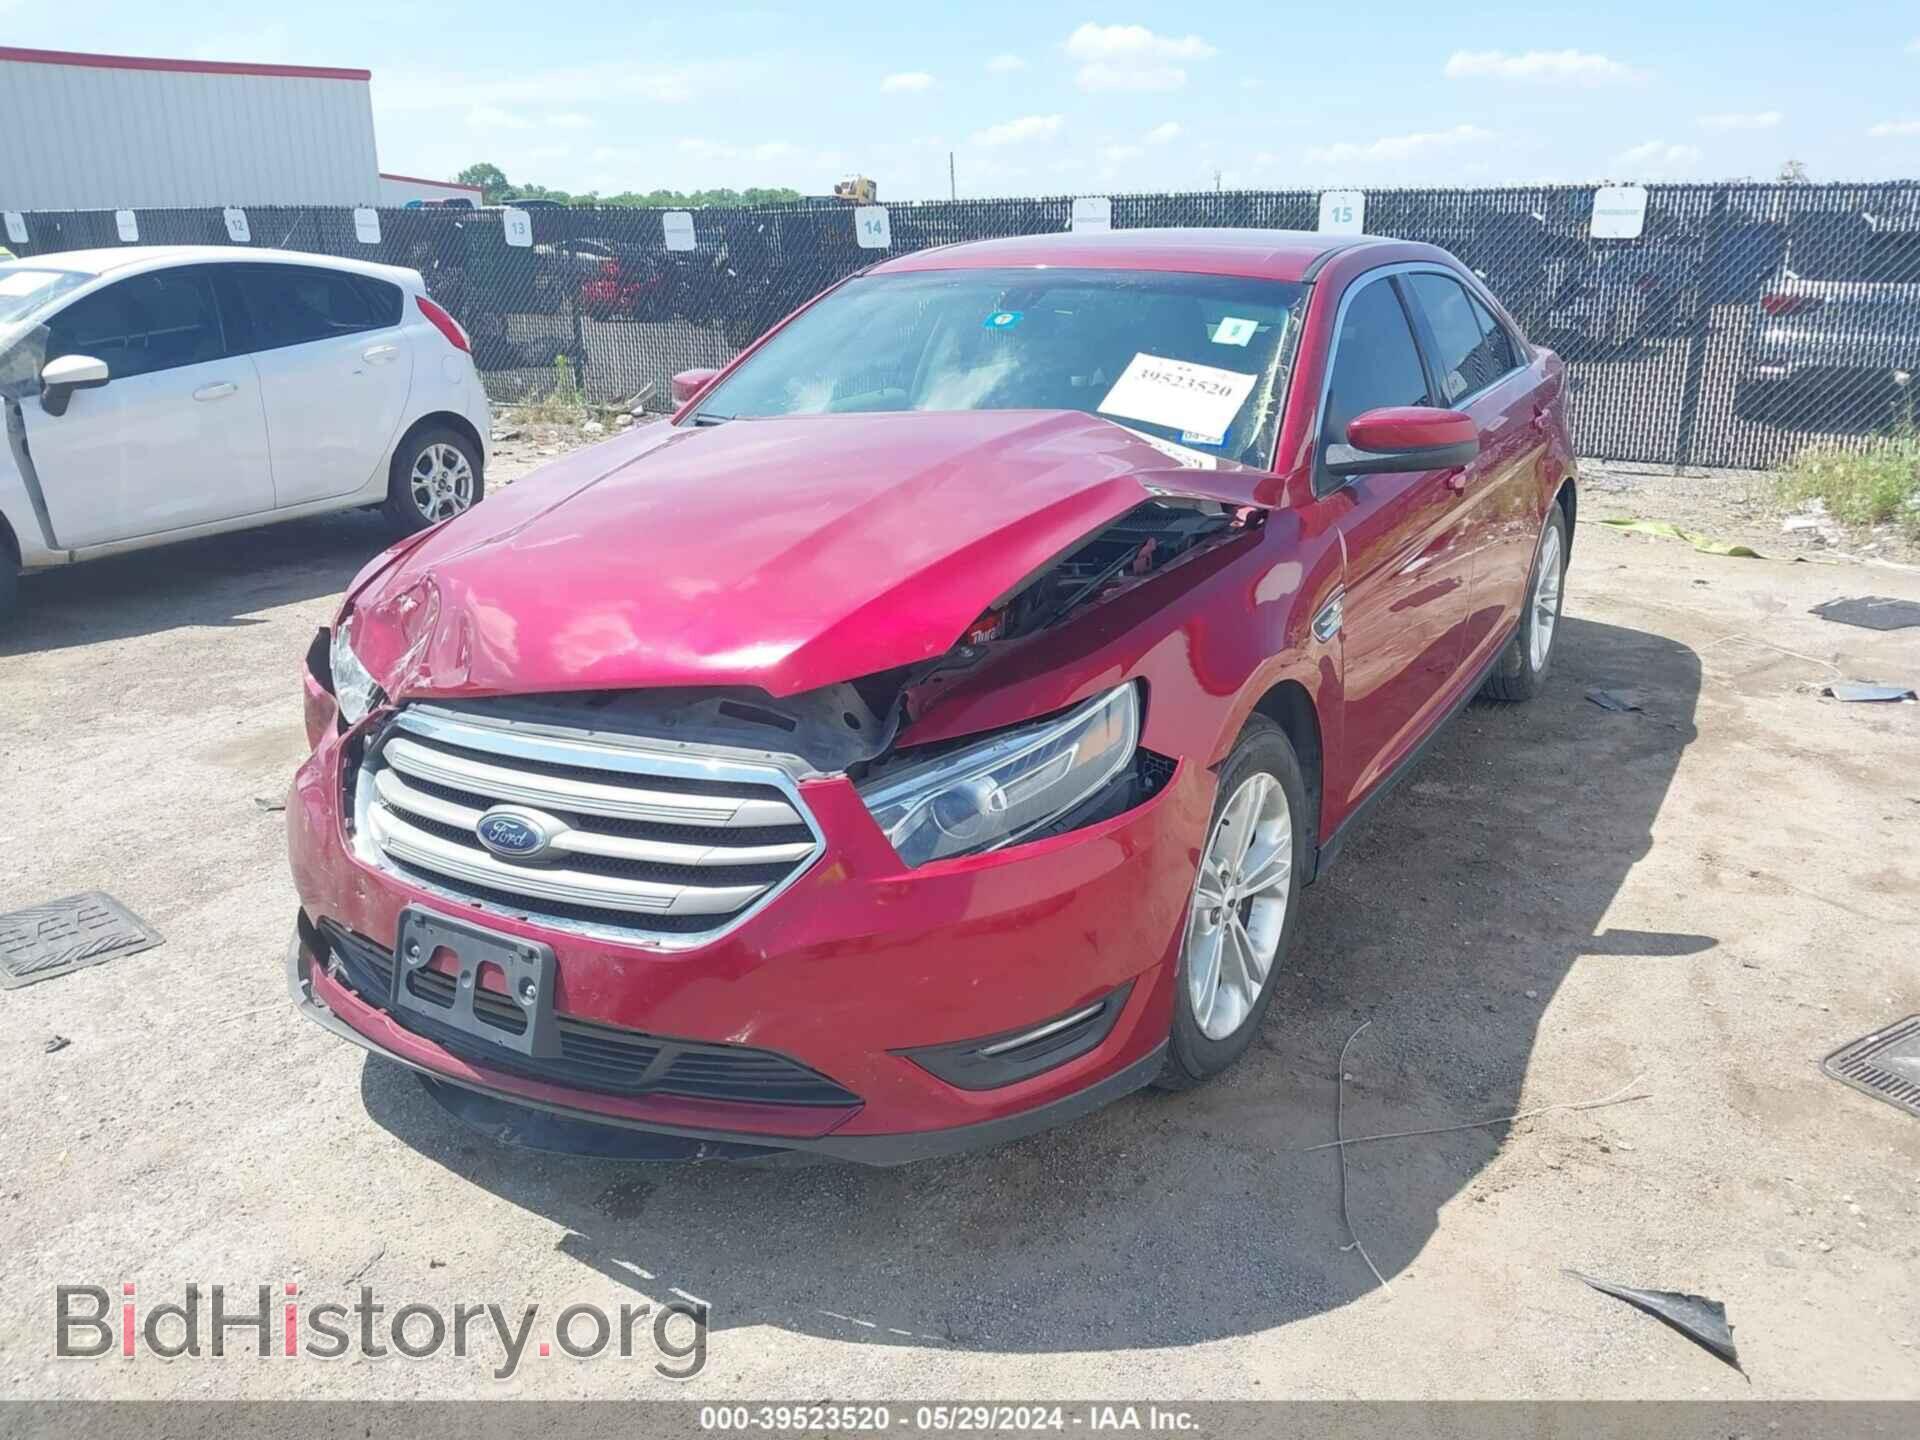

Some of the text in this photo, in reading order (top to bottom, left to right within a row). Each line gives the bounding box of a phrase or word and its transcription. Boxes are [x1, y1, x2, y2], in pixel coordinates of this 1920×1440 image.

[1331, 206, 1353, 223] 15
[231, 219, 245, 231] 12
[512, 221, 525, 235] 13
[864, 219, 882, 235] 14
[489, 820, 528, 846] Ford
